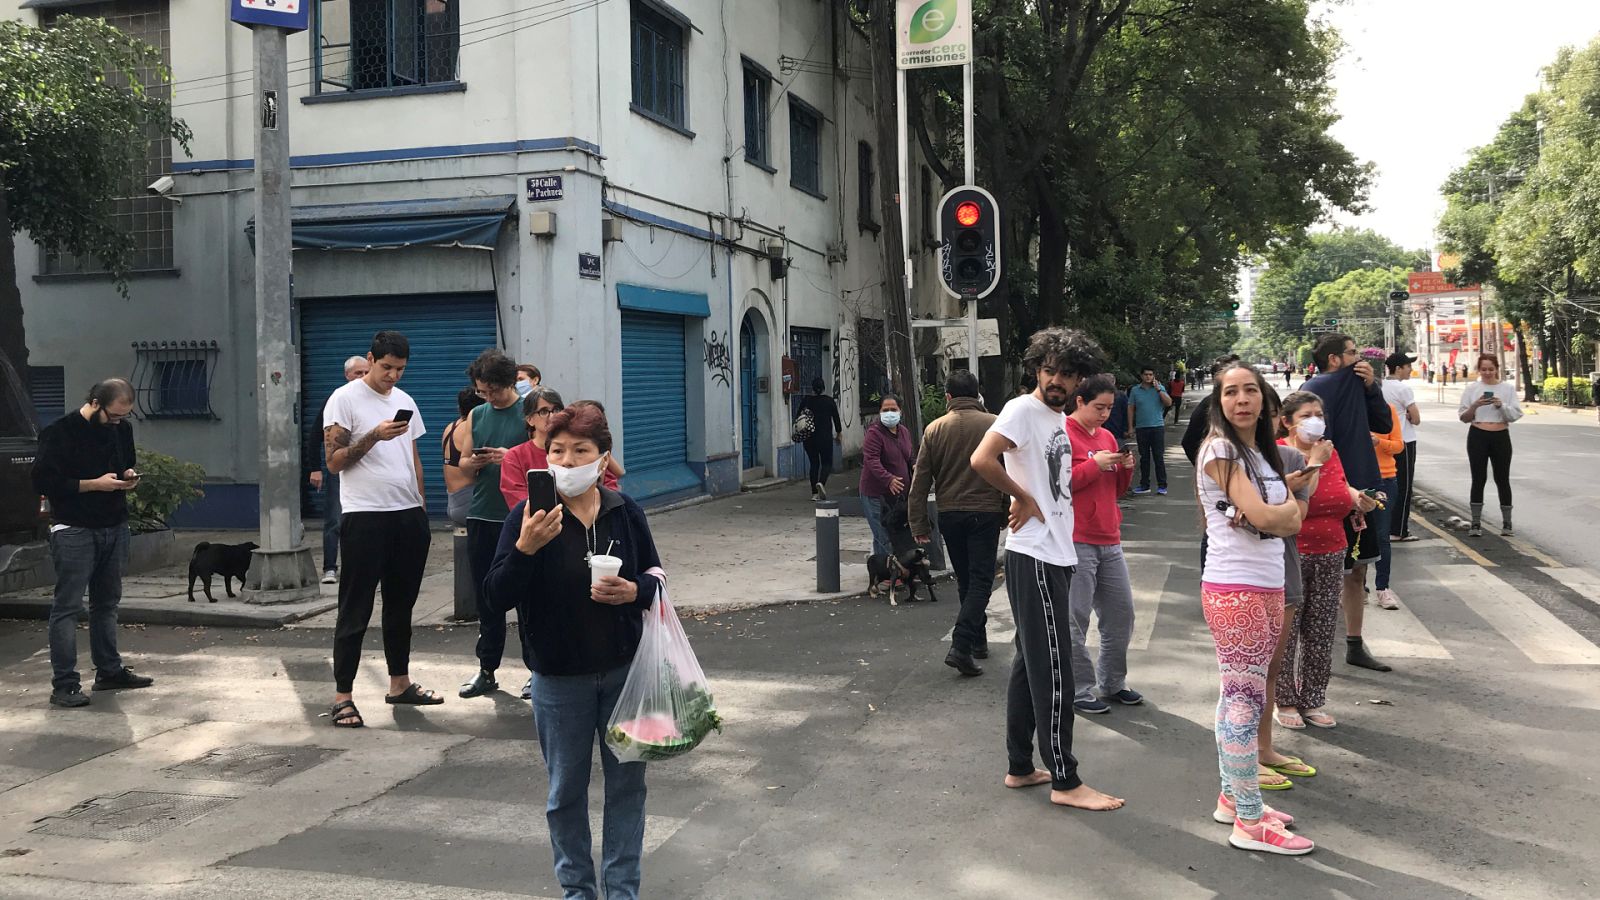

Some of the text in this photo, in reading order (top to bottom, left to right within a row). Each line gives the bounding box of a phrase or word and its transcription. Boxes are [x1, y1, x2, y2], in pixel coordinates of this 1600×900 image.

[931, 43, 966, 54] cero
[901, 52, 966, 64] emisiones
[539, 177, 558, 187] Calle
[535, 187, 563, 198] Pachuca
